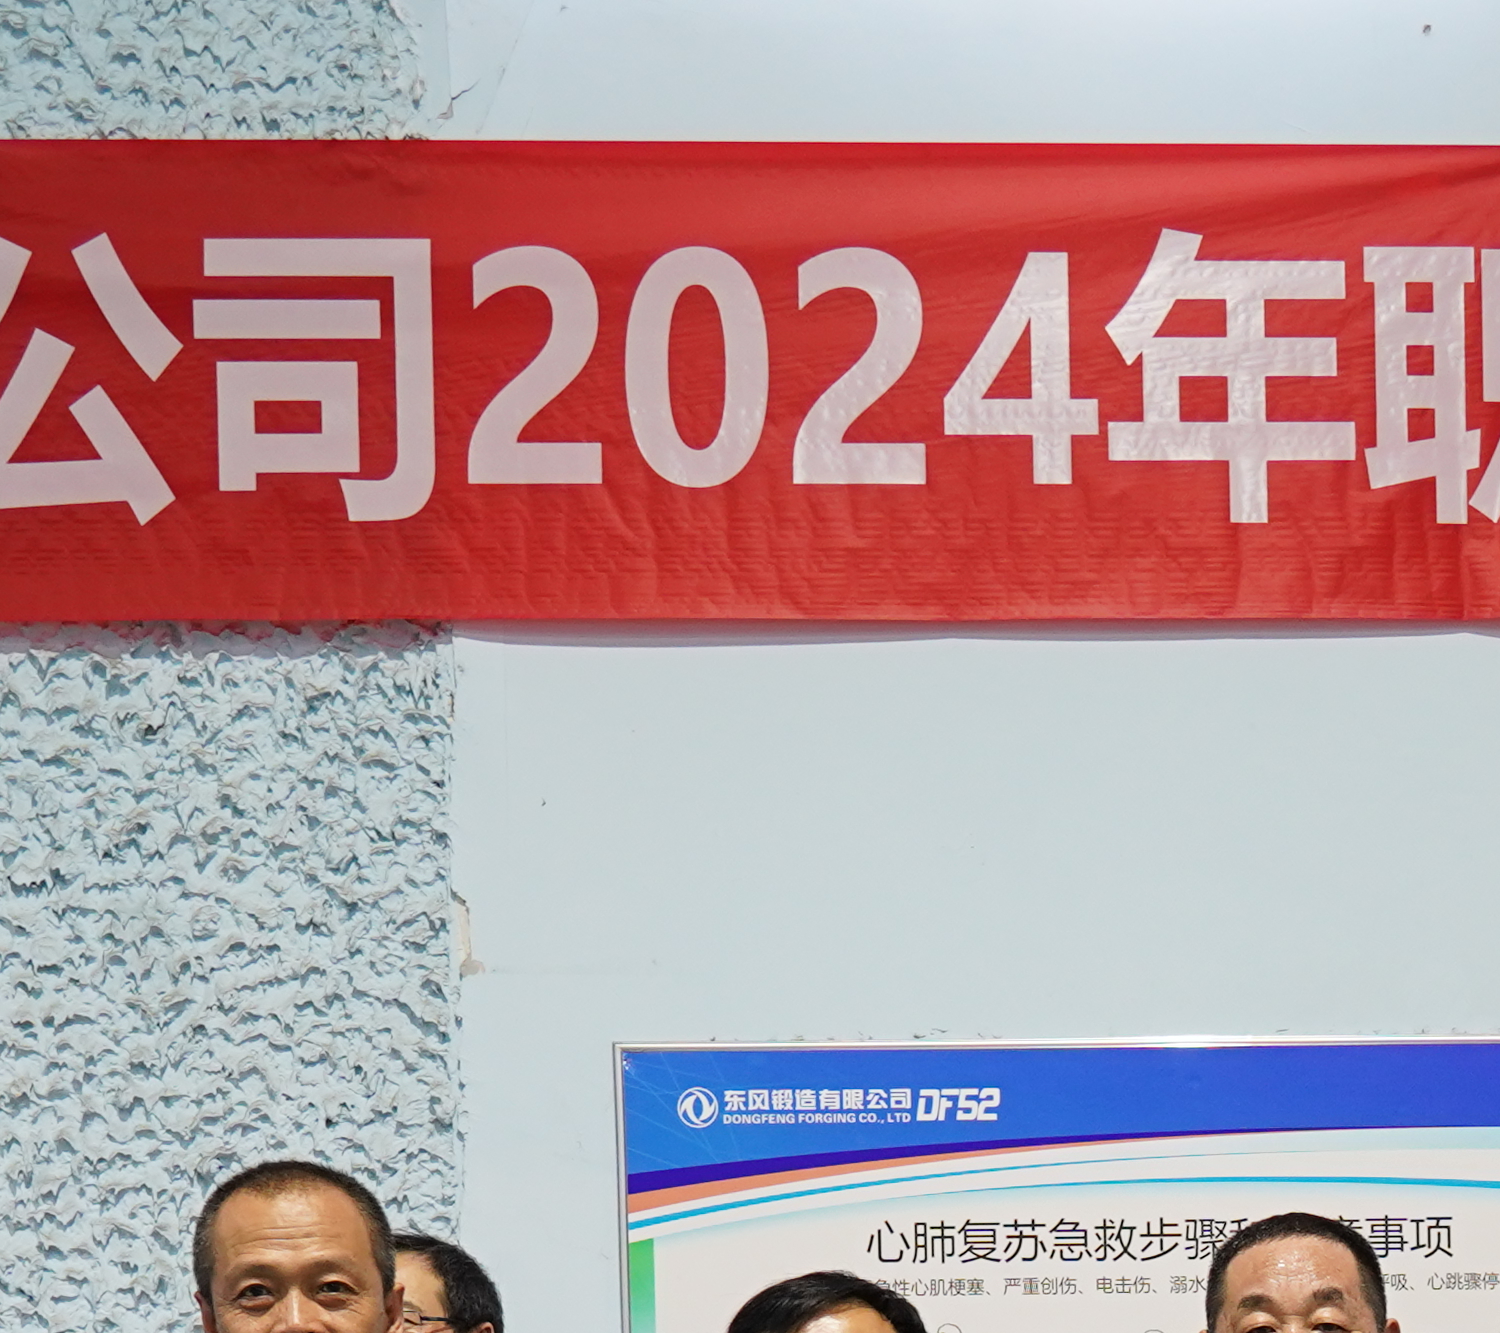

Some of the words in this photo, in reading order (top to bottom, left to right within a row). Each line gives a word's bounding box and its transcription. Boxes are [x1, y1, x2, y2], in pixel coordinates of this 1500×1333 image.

[723, 1088, 912, 1111] 东风锻造有限公司
[916, 1087, 1001, 1122] DF52
[723, 1112, 796, 1125] DONGFENG
[798, 1112, 857, 1125] FORGING
[887, 1111, 911, 1123] LTD
[1335, 1214, 1455, 1259] 事项
